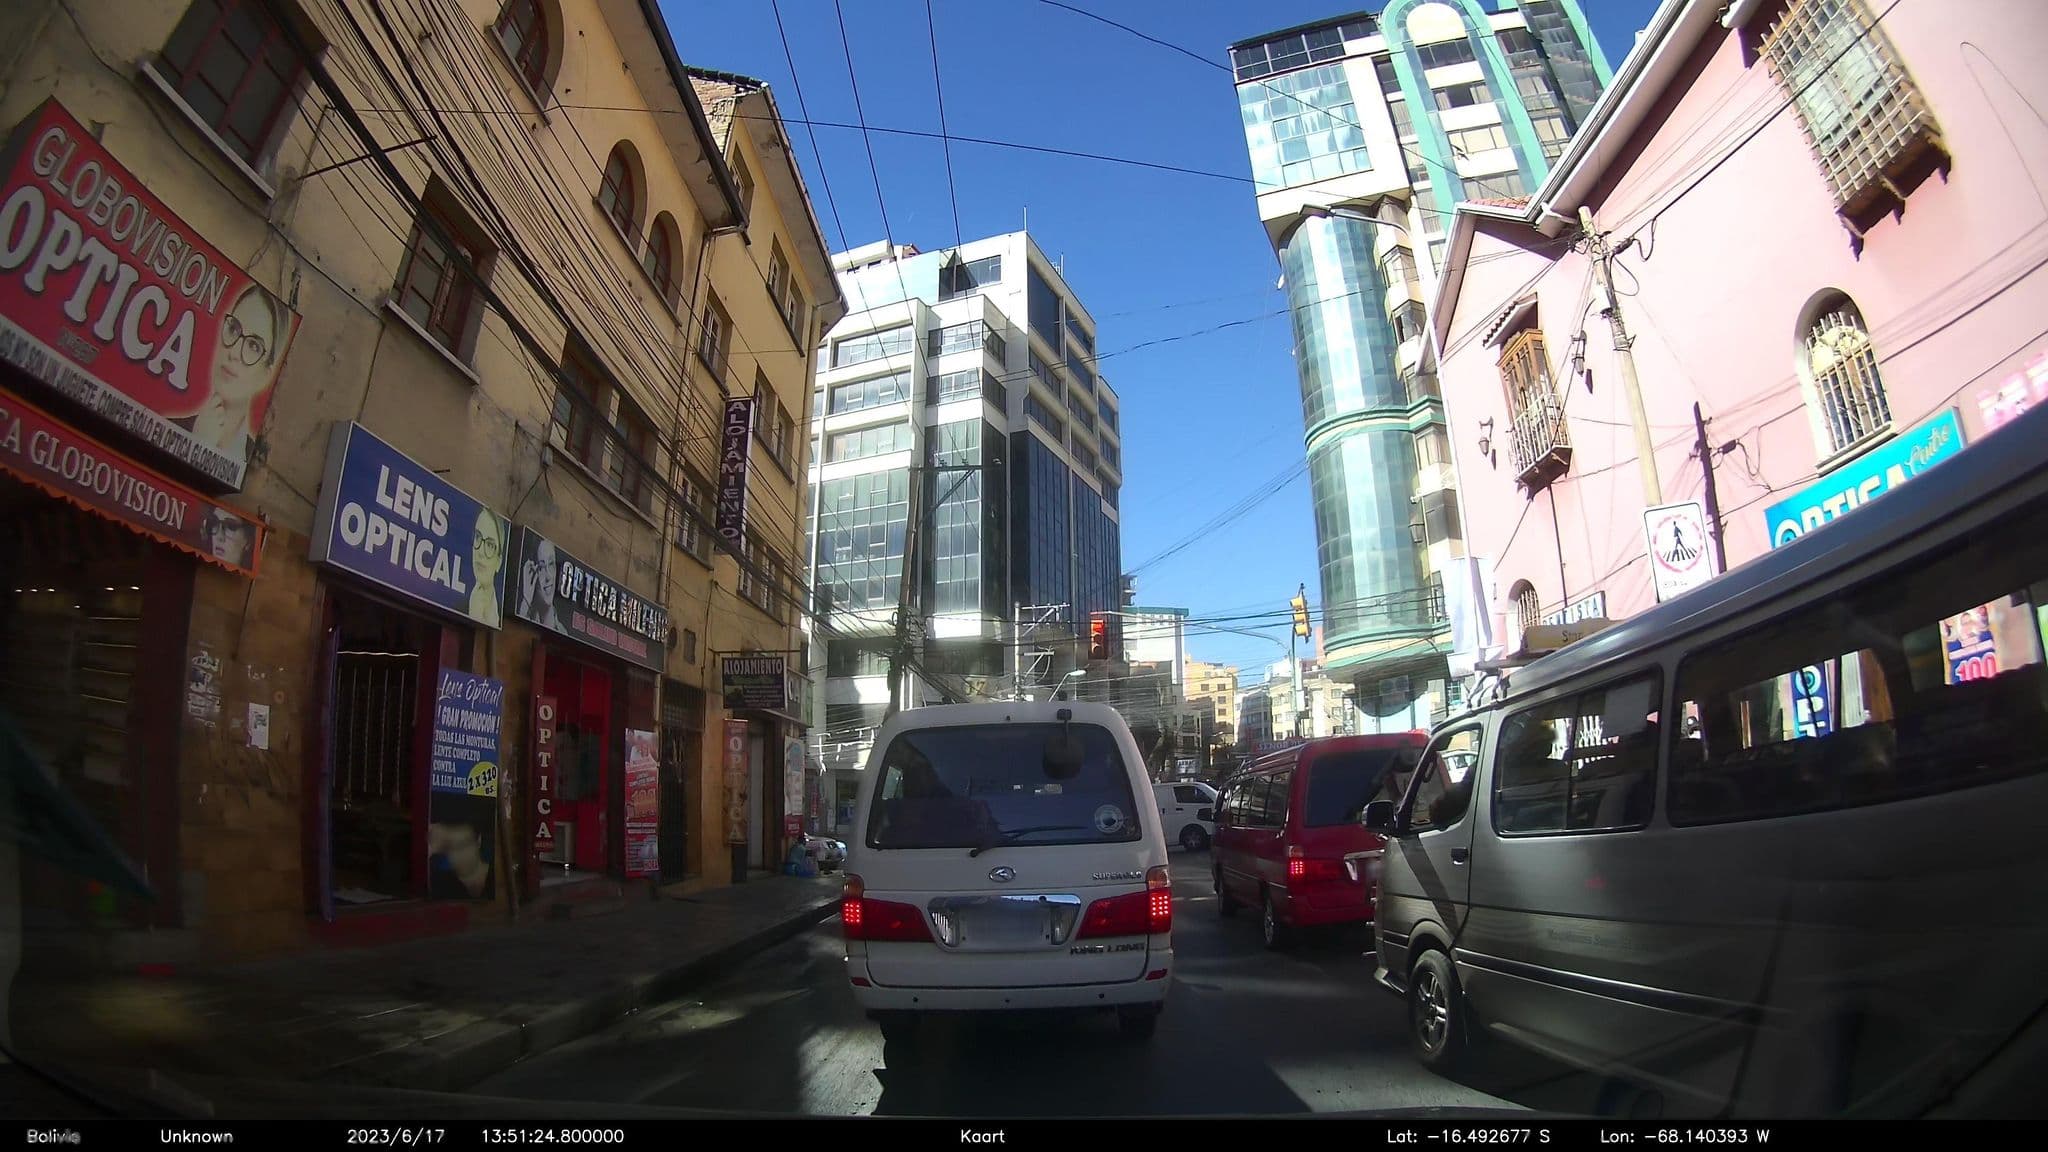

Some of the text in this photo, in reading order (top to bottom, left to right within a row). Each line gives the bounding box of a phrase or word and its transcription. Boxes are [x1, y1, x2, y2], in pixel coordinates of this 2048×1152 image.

[31, 126, 231, 315] GLOBOVISION
[0, 185, 196, 391] OPTICA
[30, 430, 188, 531] GLOBOVISION
[375, 464, 450, 537] LENS
[718, 401, 747, 538] ALOJAMIENTO
[339, 501, 466, 594] OPTICAL
[560, 561, 617, 622] OPTICA
[439, 673, 503, 709] Lens Optical
[724, 658, 782, 675] ALOJAMIENTO
[536, 704, 553, 838] OPTICA
